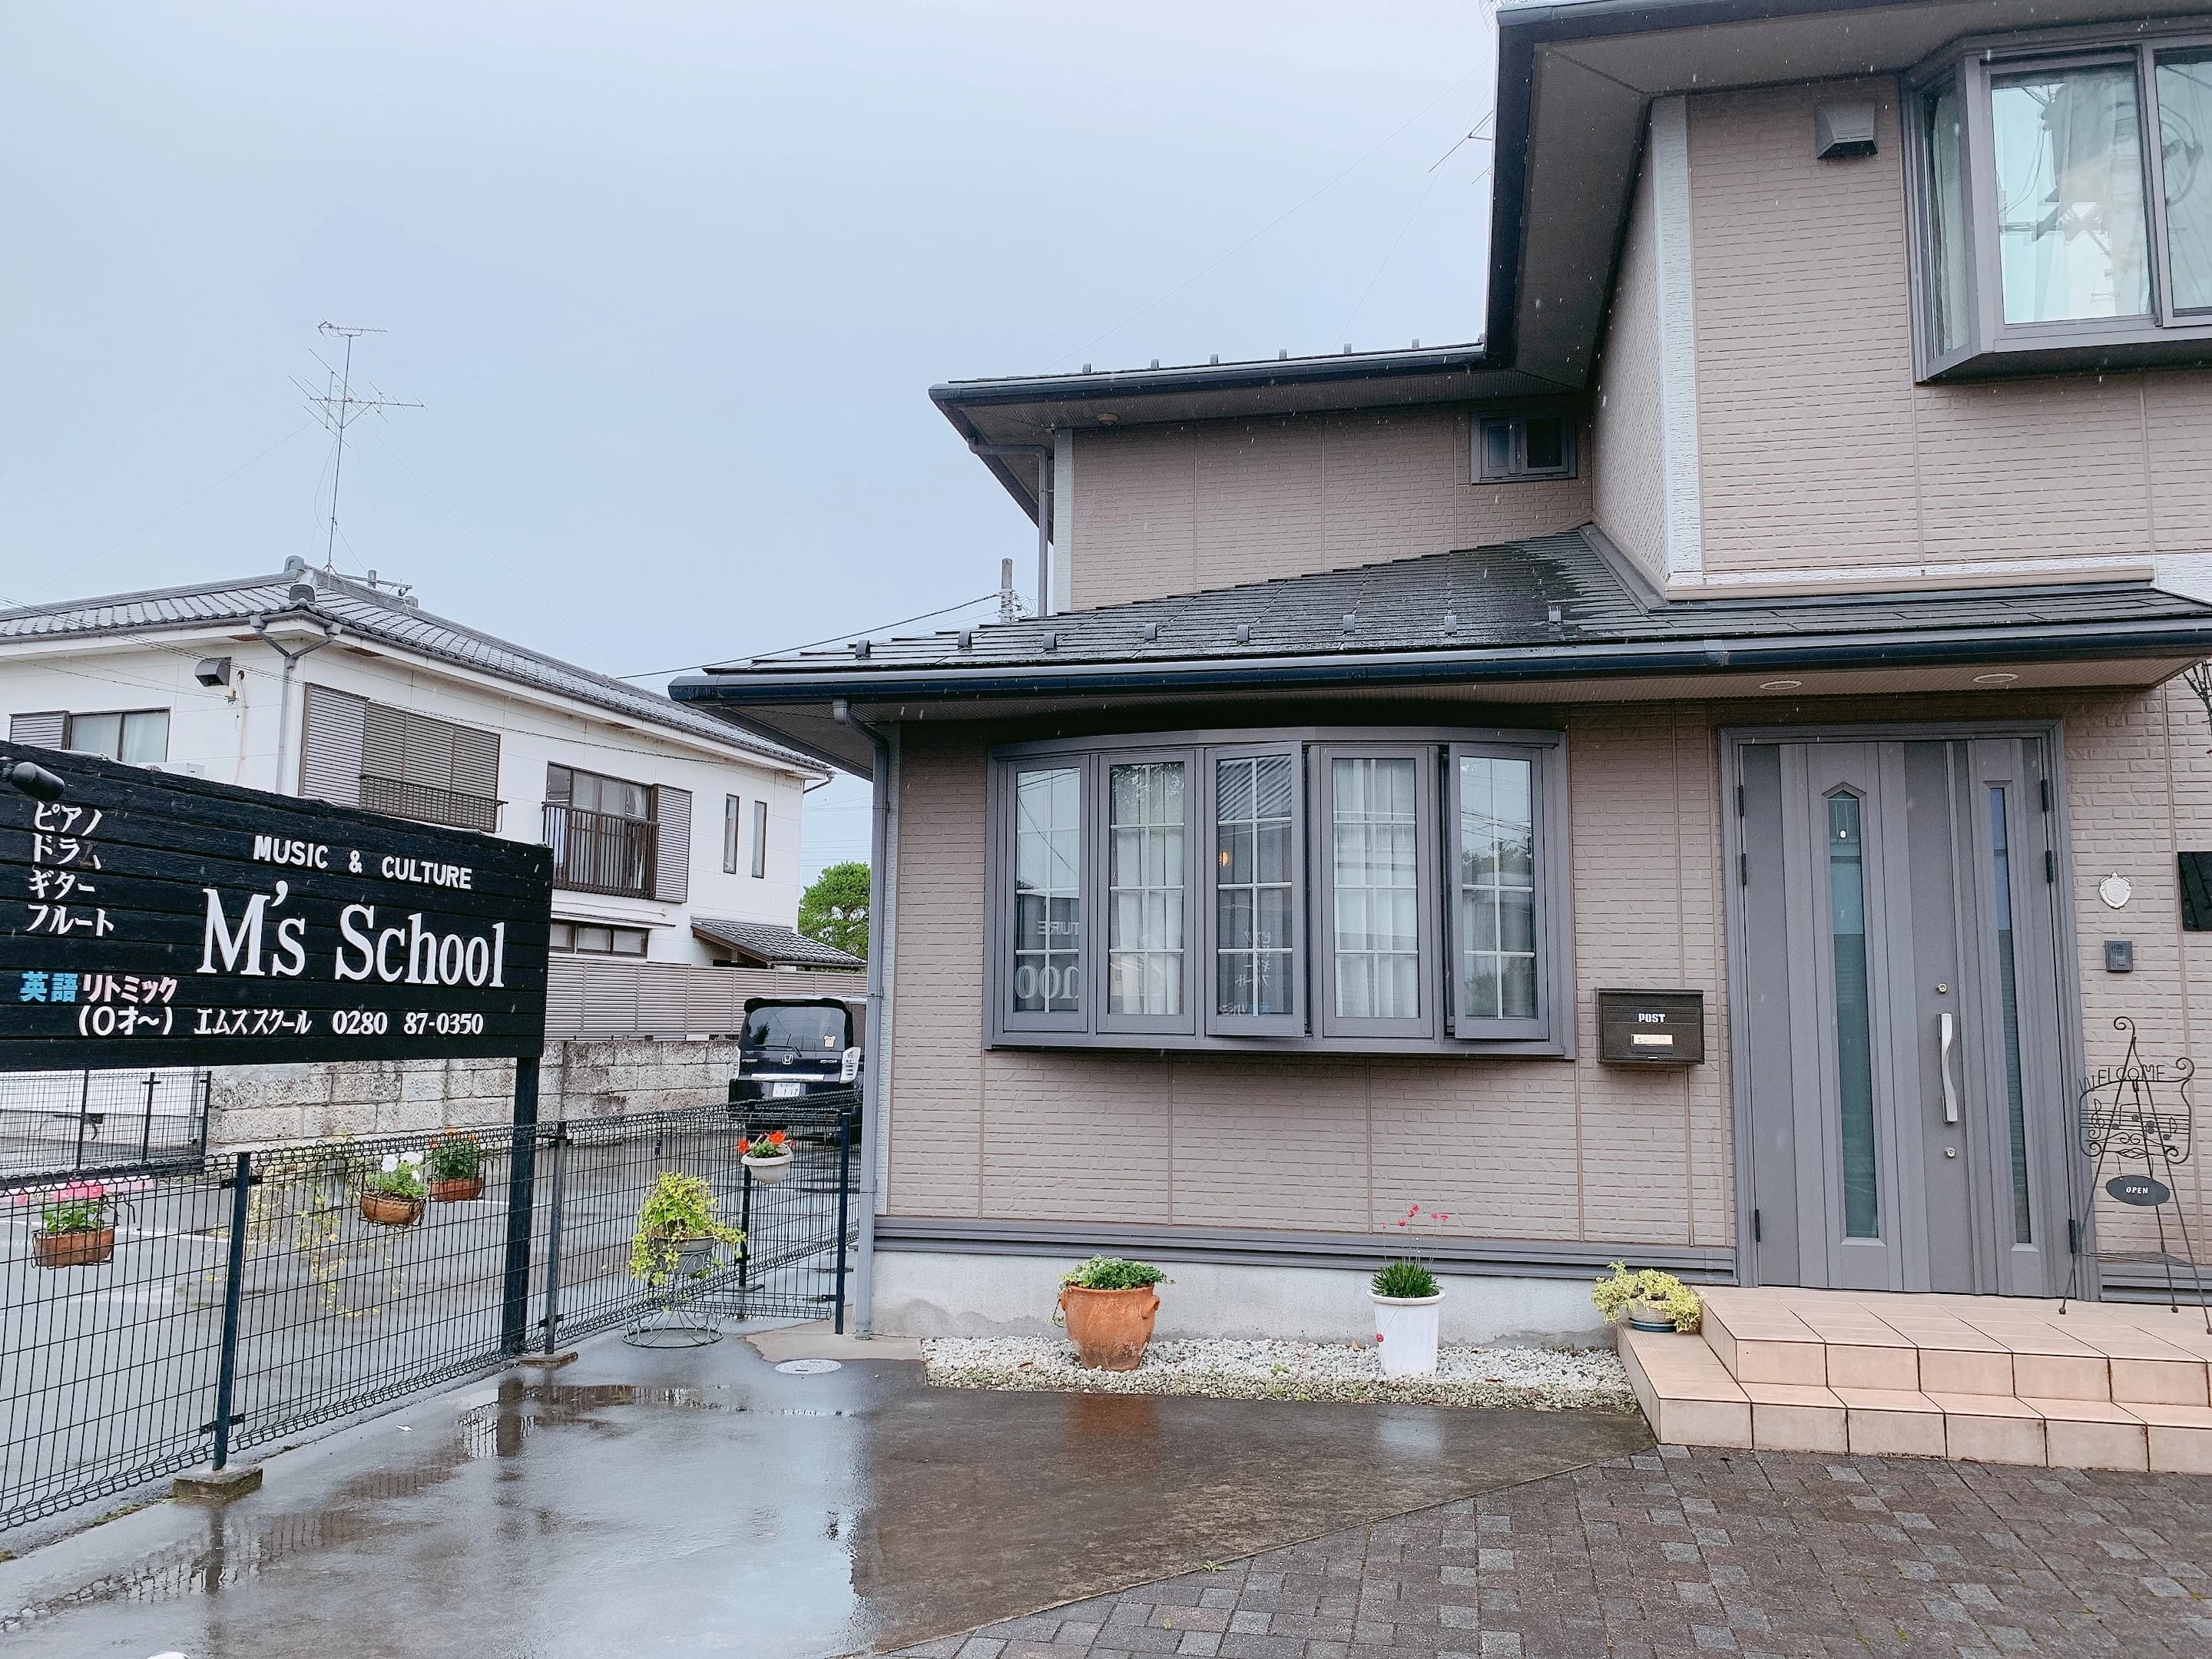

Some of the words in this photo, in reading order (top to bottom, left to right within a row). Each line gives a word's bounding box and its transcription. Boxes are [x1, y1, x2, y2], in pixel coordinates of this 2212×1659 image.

[34, 800, 103, 836] ピアノ
[253, 835, 329, 869] MUSIC
[349, 849, 363, 873] &
[381, 856, 473, 889] CULTURE
[28, 869, 96, 900] ギター
[25, 904, 114, 937] フルート
[196, 880, 306, 976] M's
[335, 903, 505, 988] School
[20, 971, 78, 1002] 英語
[82, 974, 178, 1003] リトミック
[332, 1010, 388, 1035] 0280
[403, 1012, 484, 1035] 87-0350
[1637, 1012, 1666, 1023] POST
[2078, 1064, 2166, 1093] WELCOME
[2125, 1186, 2148, 1194] OPEN
